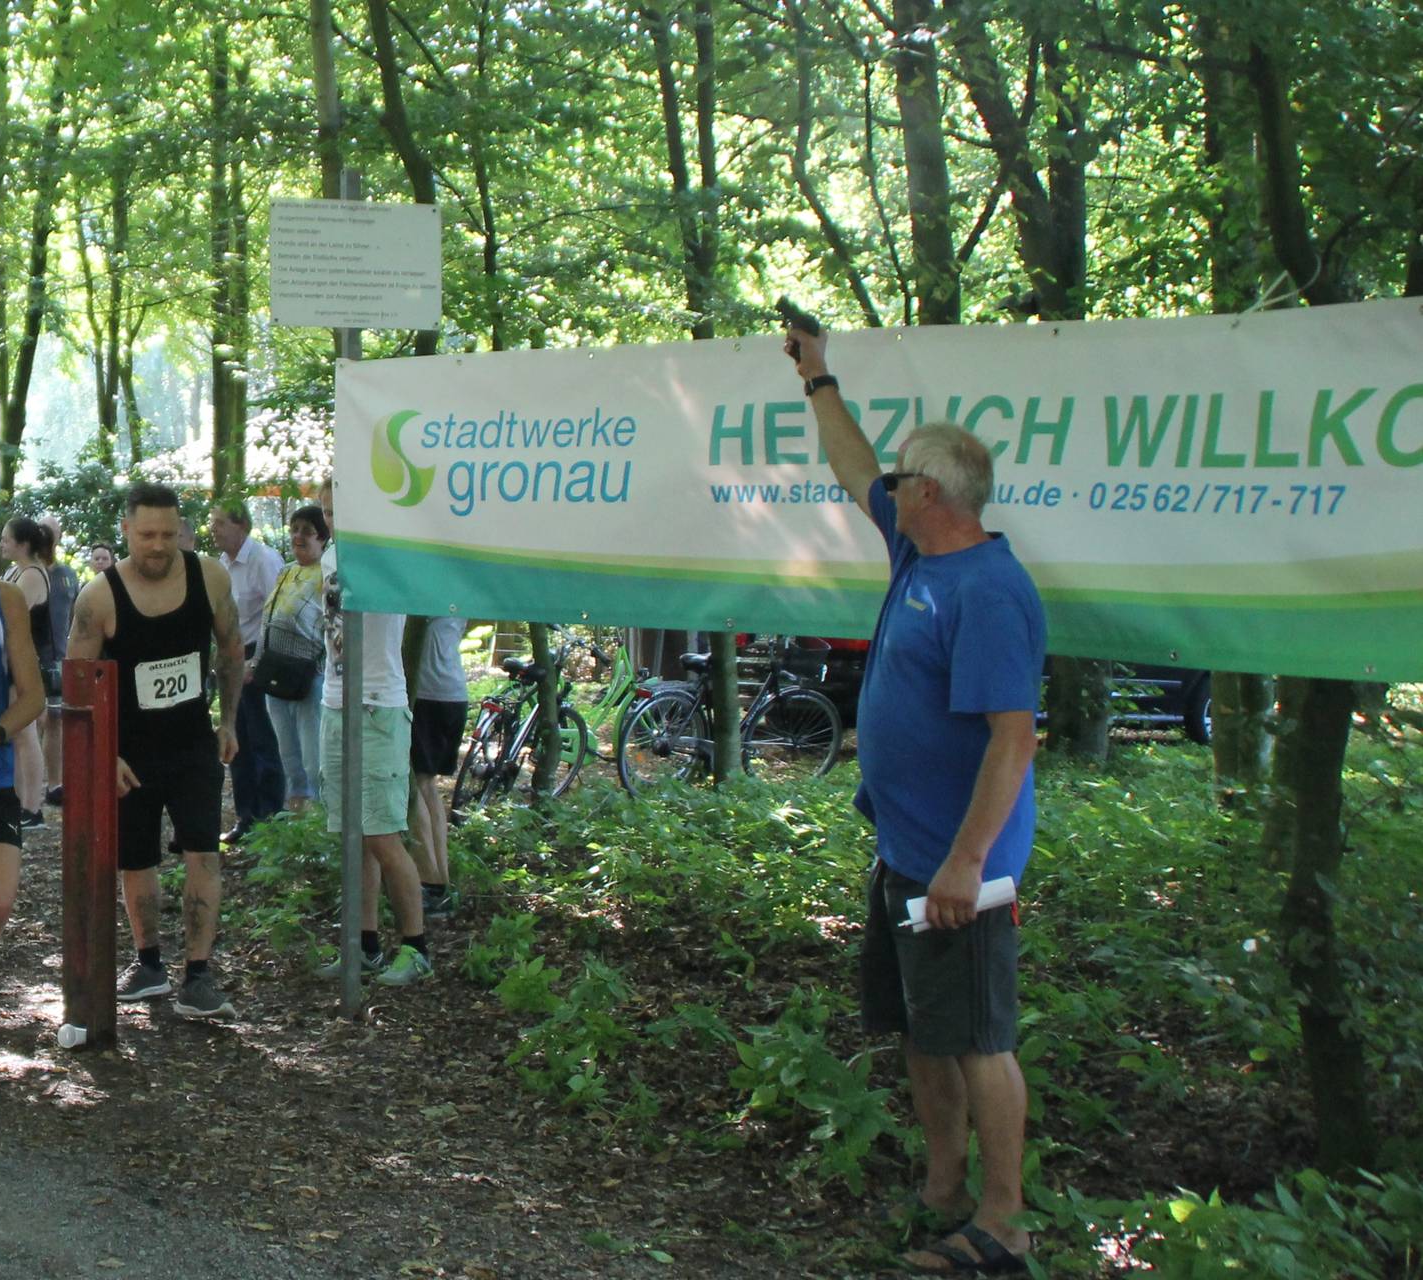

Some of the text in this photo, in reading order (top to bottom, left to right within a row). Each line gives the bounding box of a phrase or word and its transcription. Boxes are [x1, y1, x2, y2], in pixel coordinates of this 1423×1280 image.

[420, 406, 637, 449] stadtwerke
[447, 459, 633, 517] gronau
[149, 658, 188, 671] attractic
[153, 674, 187, 699] 220
